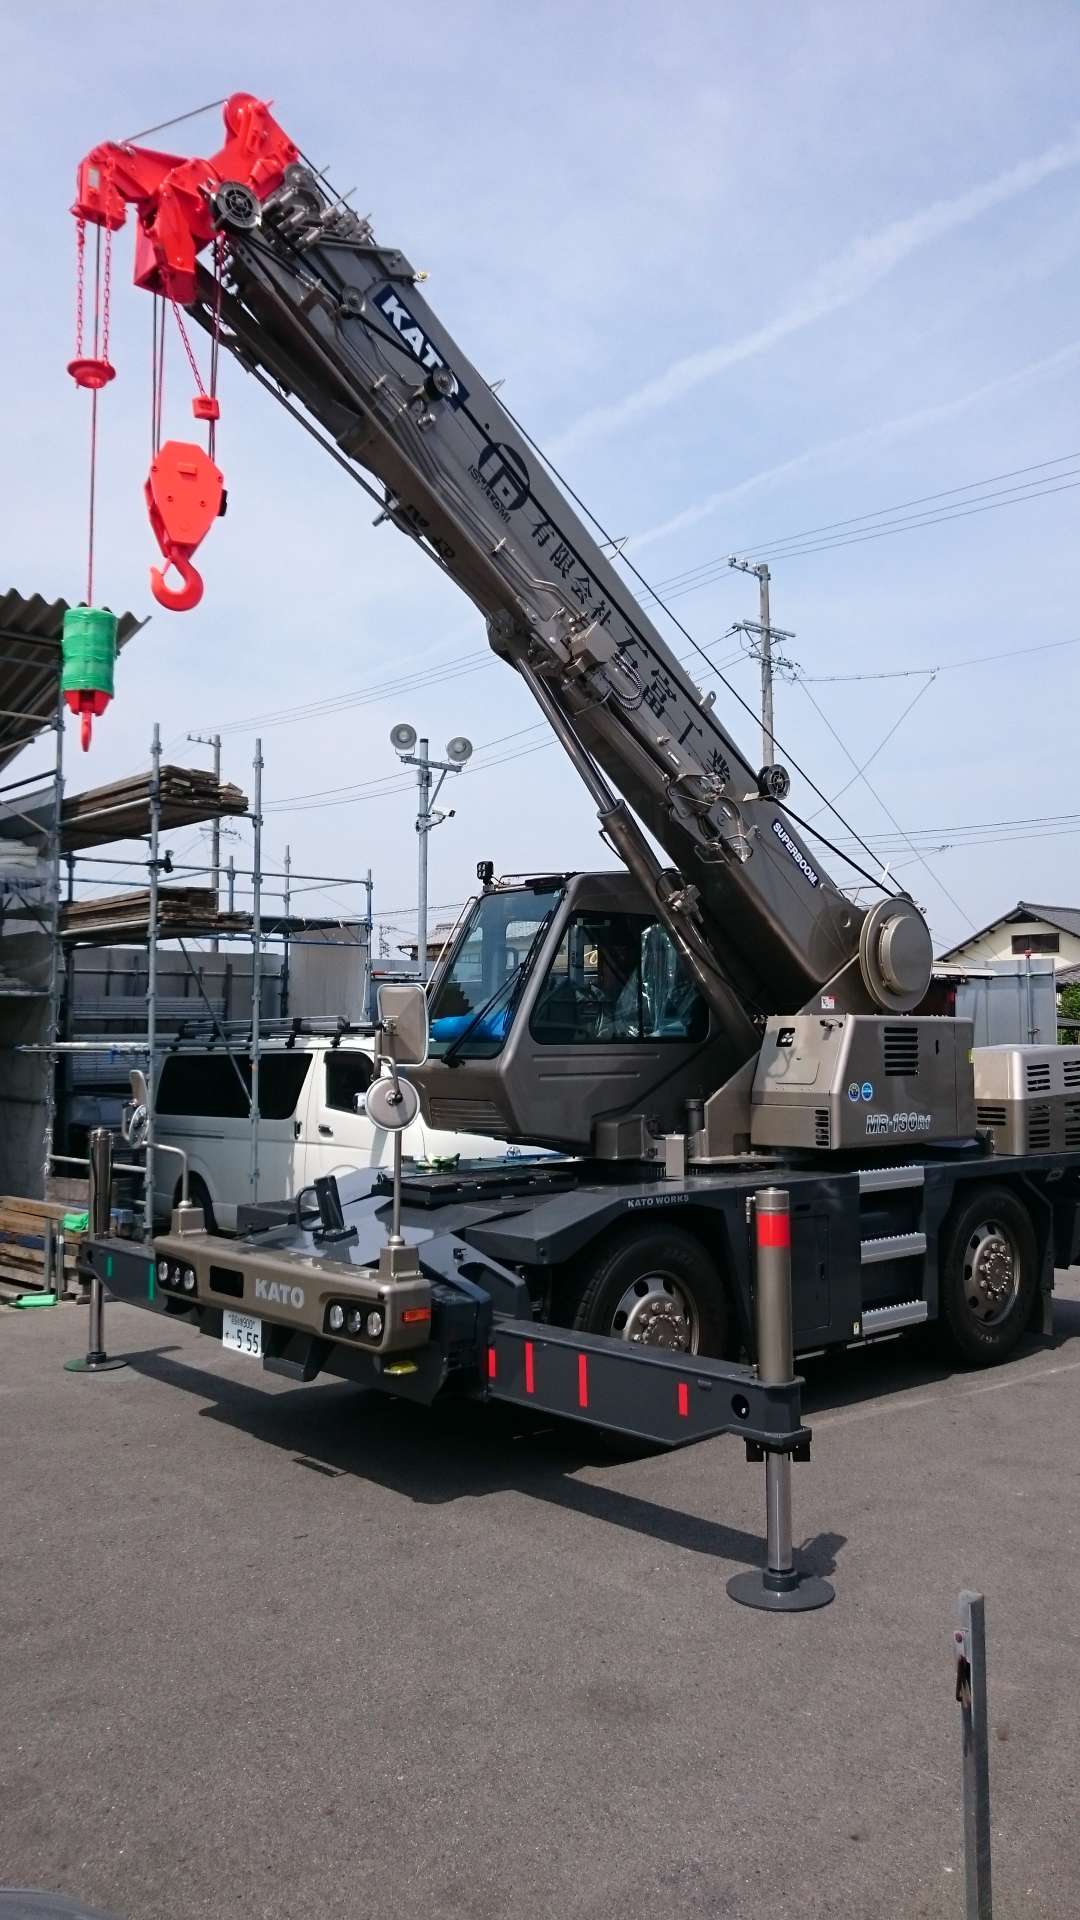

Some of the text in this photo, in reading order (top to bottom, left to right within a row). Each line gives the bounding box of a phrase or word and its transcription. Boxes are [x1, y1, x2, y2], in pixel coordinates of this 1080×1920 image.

[381, 294, 457, 392] KAT
[773, 822, 818, 885] SUPERBOOM
[627, 1194, 689, 1208] KATO WORKS
[255, 1278, 304, 1309] KATO
